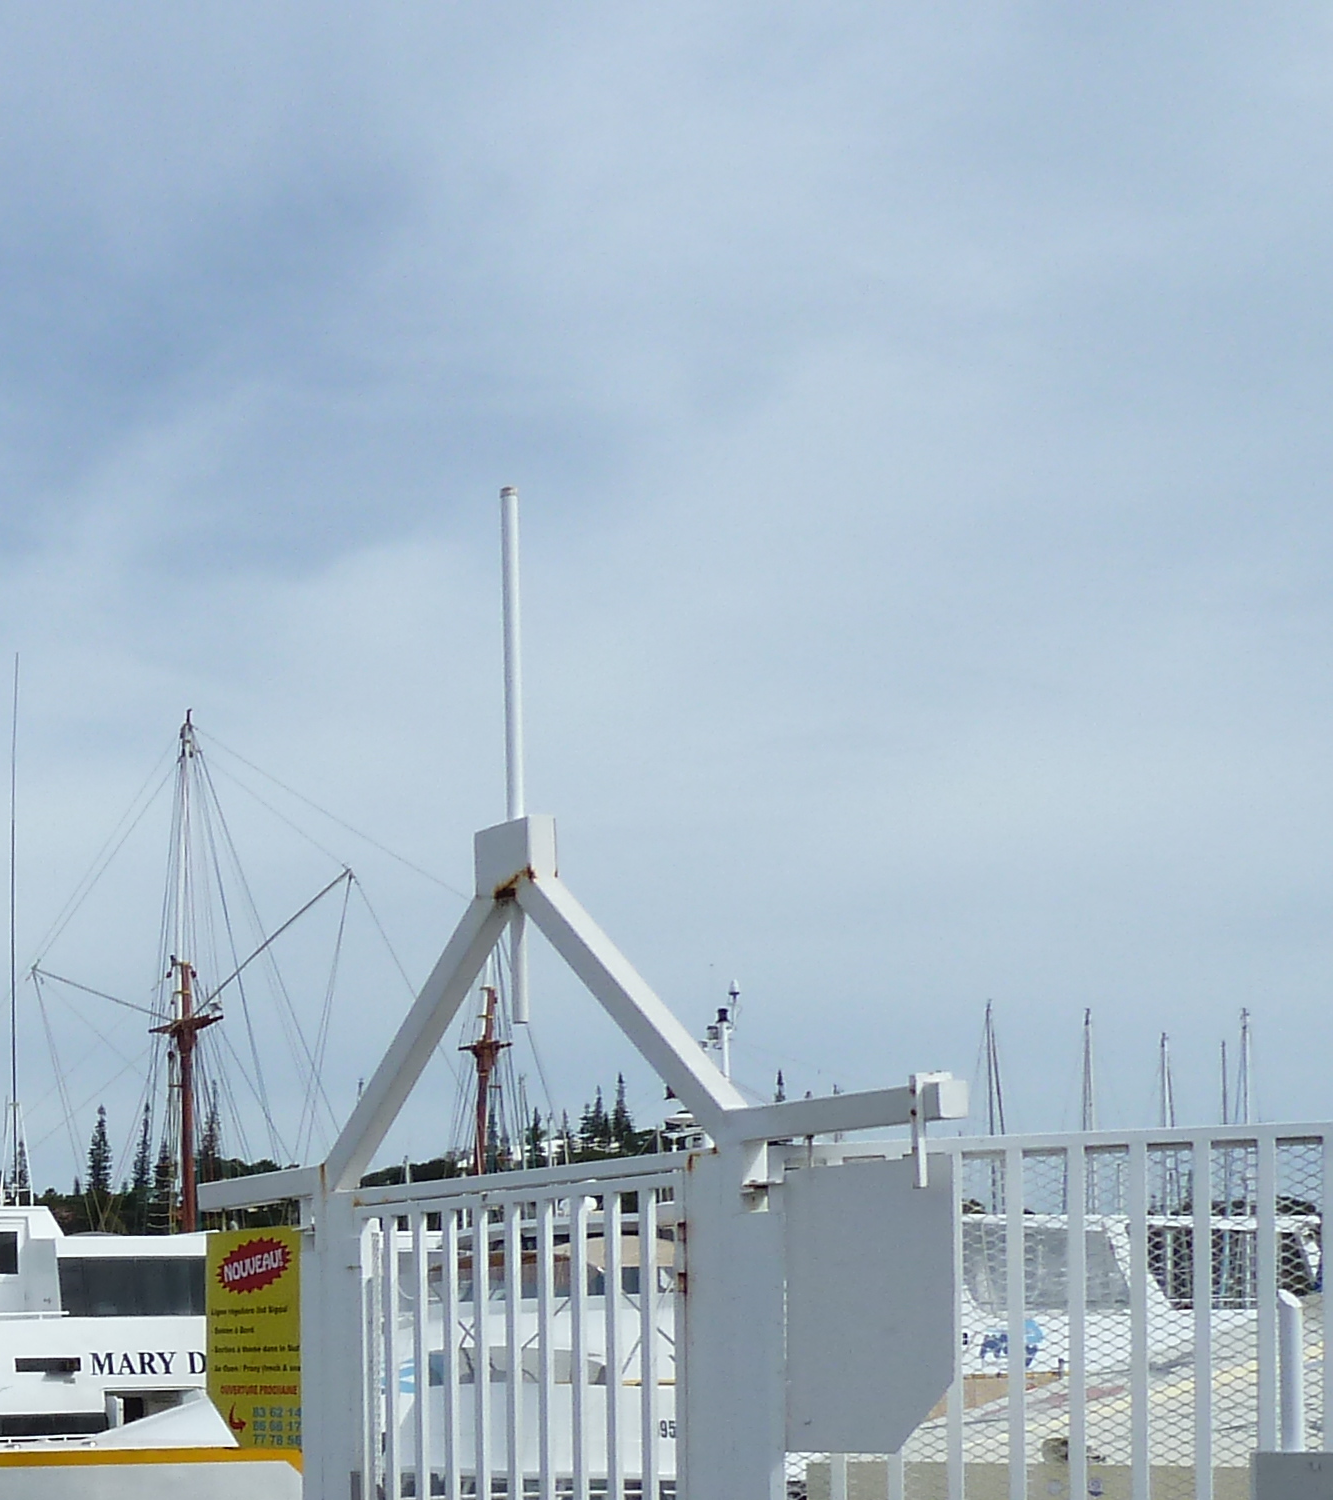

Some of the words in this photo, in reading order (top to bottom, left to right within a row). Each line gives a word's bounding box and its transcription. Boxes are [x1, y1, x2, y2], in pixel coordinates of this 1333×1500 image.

[223, 1248, 285, 1283] NOUVEAU!
[89, 1351, 177, 1376] MARY
[186, 1351, 206, 1375] D
